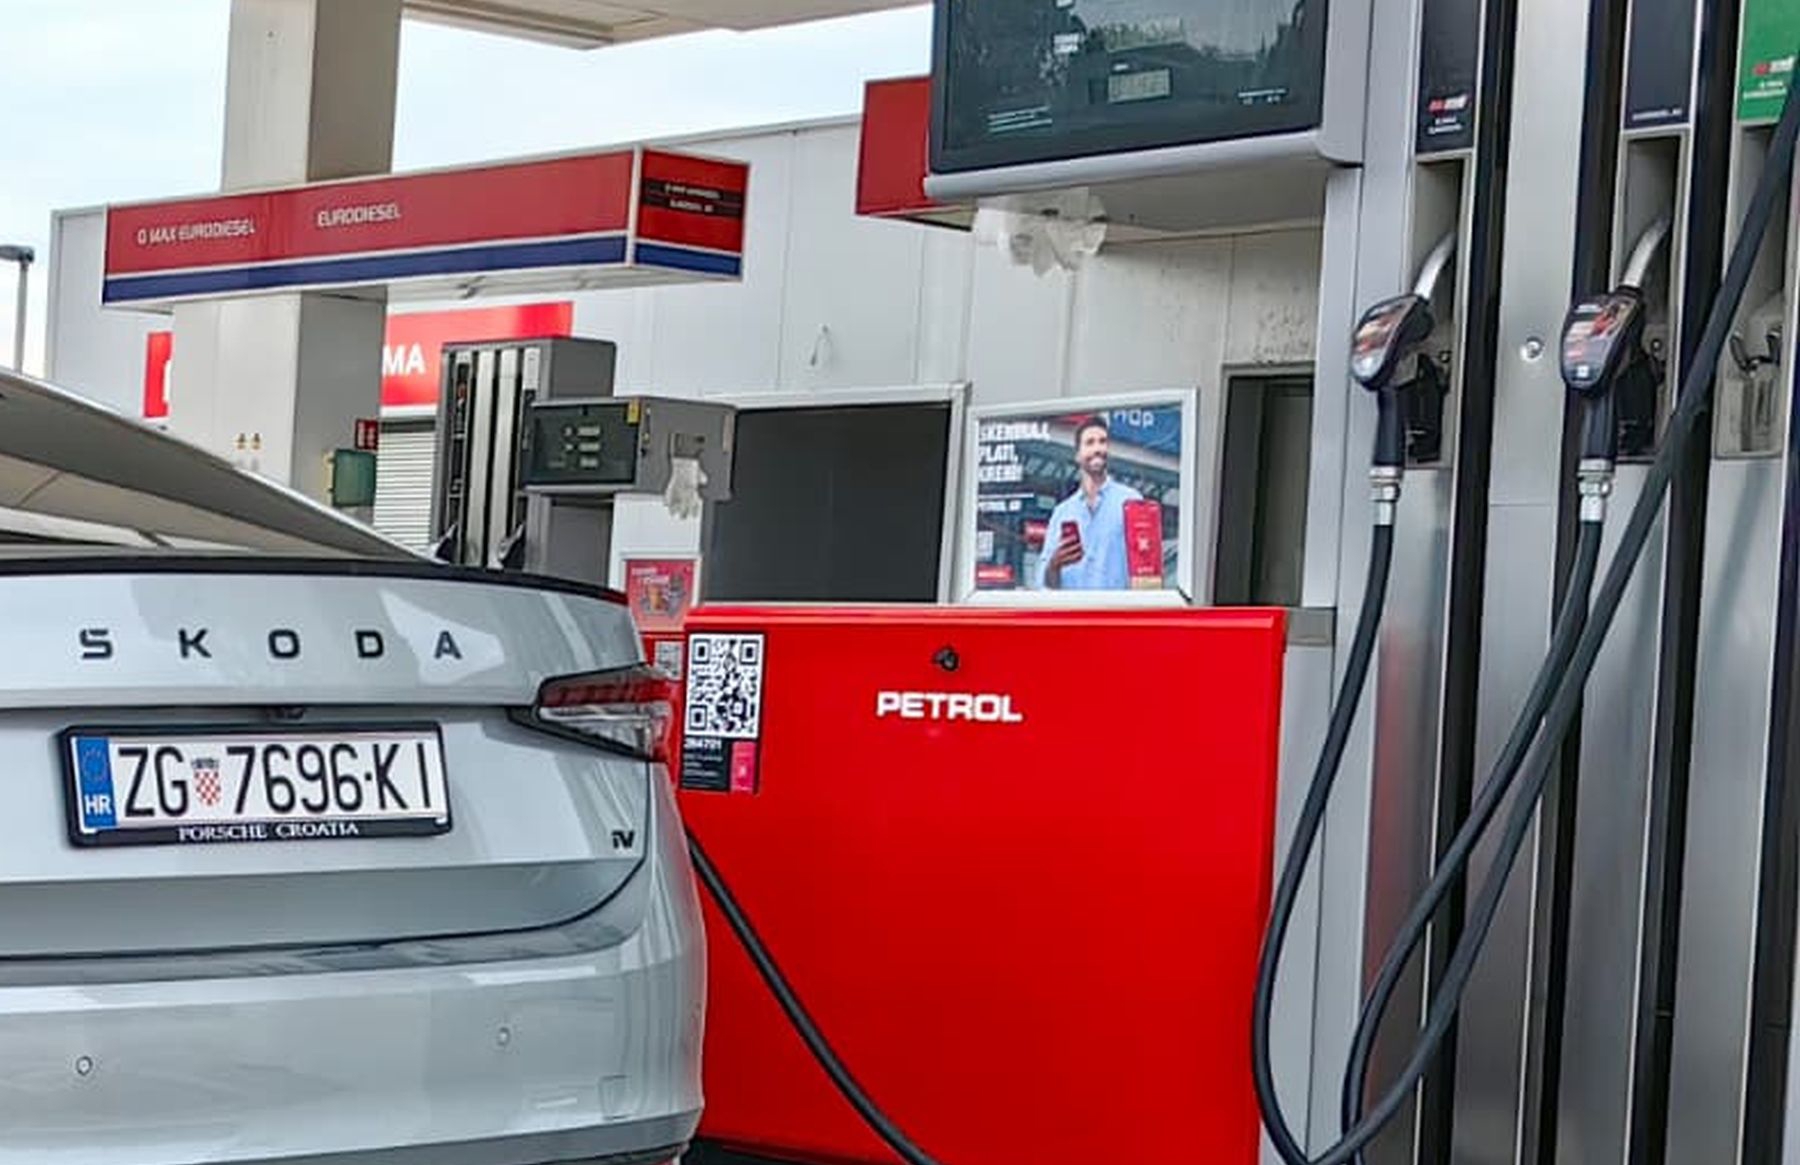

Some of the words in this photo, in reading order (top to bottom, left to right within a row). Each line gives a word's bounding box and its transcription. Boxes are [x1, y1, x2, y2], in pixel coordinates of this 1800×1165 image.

[317, 204, 400, 228] EURODIESEL
[178, 218, 256, 241] EURODIESEL
[80, 628, 463, 661] SKODA
[876, 690, 1023, 722] PETROL
[117, 745, 189, 818] ZG
[84, 794, 112, 816] HR
[178, 826, 268, 842] PORSCHE
[275, 823, 359, 839] CROATIA
